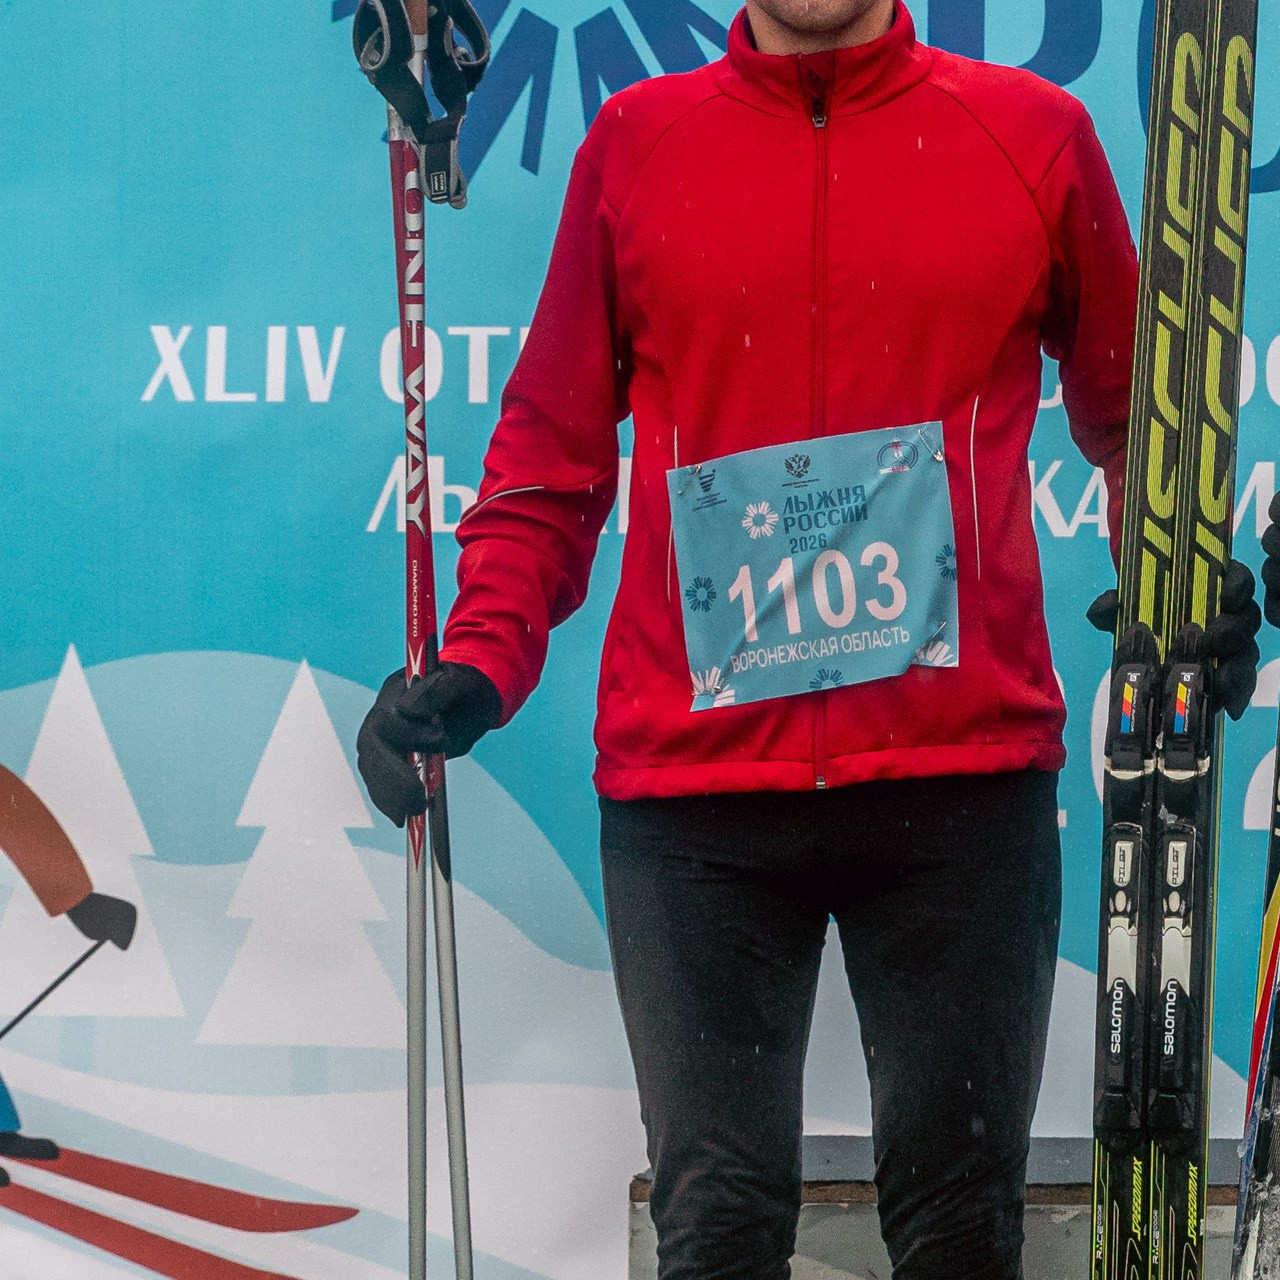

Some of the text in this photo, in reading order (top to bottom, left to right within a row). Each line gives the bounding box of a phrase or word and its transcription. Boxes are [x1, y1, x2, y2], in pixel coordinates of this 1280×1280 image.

[142, 325, 345, 403] XLIV
[402, 364, 428, 538] WAY
[783, 484, 866, 515] ЛЫЖНЯ
[783, 504, 868, 535] РОССИИ
[789, 533, 828, 555] 2026
[727, 541, 908, 643] 1103
[730, 625, 910, 674] ВОРОНЕЖСКАЯ ОБЛАСТЬ
[1118, 846, 1127, 884] PILOT
[1171, 846, 1180, 885] PILOT
